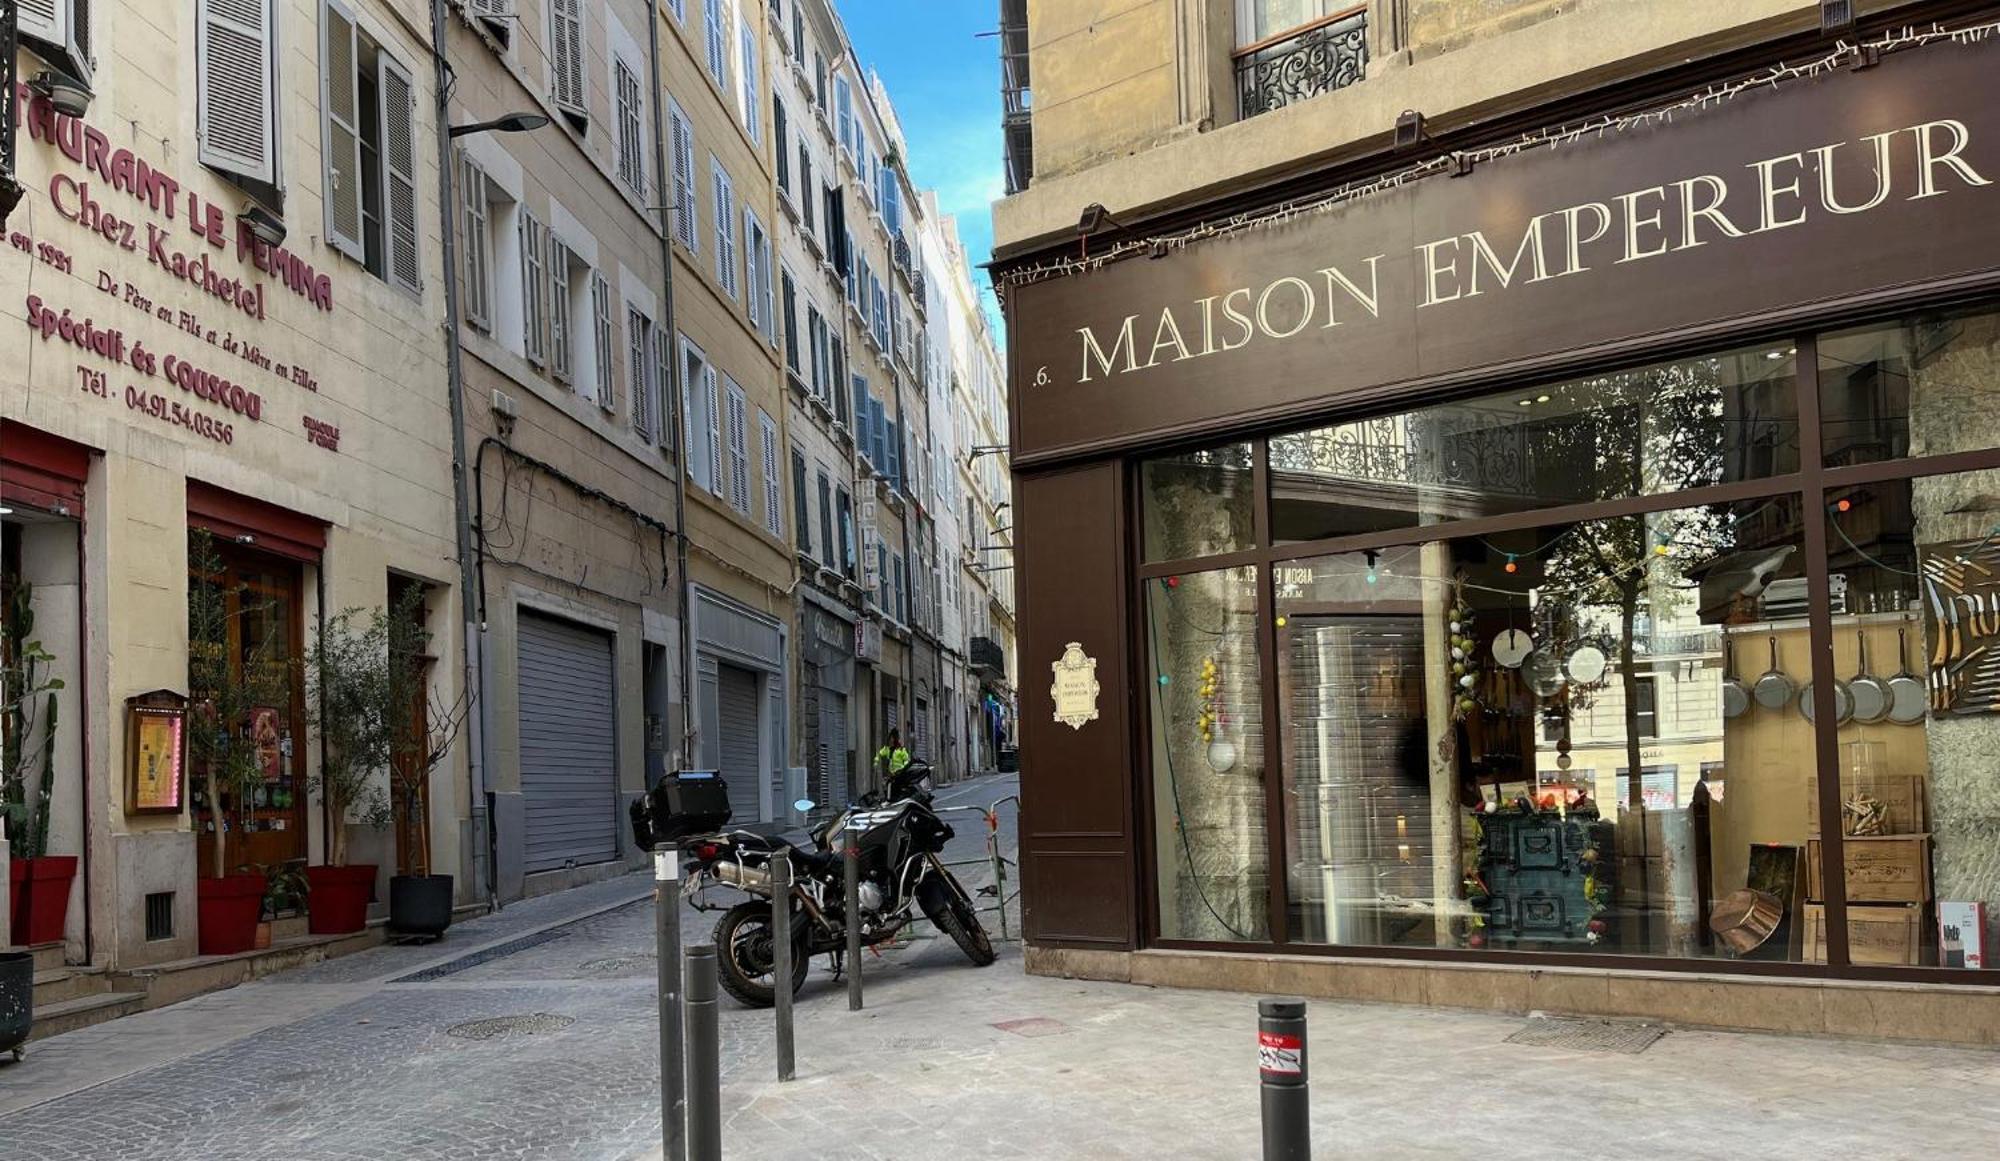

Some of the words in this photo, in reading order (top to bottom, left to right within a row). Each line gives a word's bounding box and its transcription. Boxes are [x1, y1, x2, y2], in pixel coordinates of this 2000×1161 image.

[11, 232, 33, 253] en
[50, 174, 137, 250] Chez
[147, 222, 266, 320] Kachetel
[188, 191, 226, 249] LE
[236, 217, 333, 311] FEMINA
[1075, 254, 1386, 383] MAISON
[1414, 119, 1994, 308] EMPEREUR
[97, 270, 118, 297] De
[124, 283, 153, 314] Père
[157, 306, 172, 324] en
[178, 310, 201, 338] Fils
[206, 330, 217, 345] et
[223, 332, 238, 354] de
[241, 341, 271, 370] Mère
[275, 363, 288, 379] en
[292, 365, 318, 393] Filles
[856, 620, 865, 657] HOTEL
